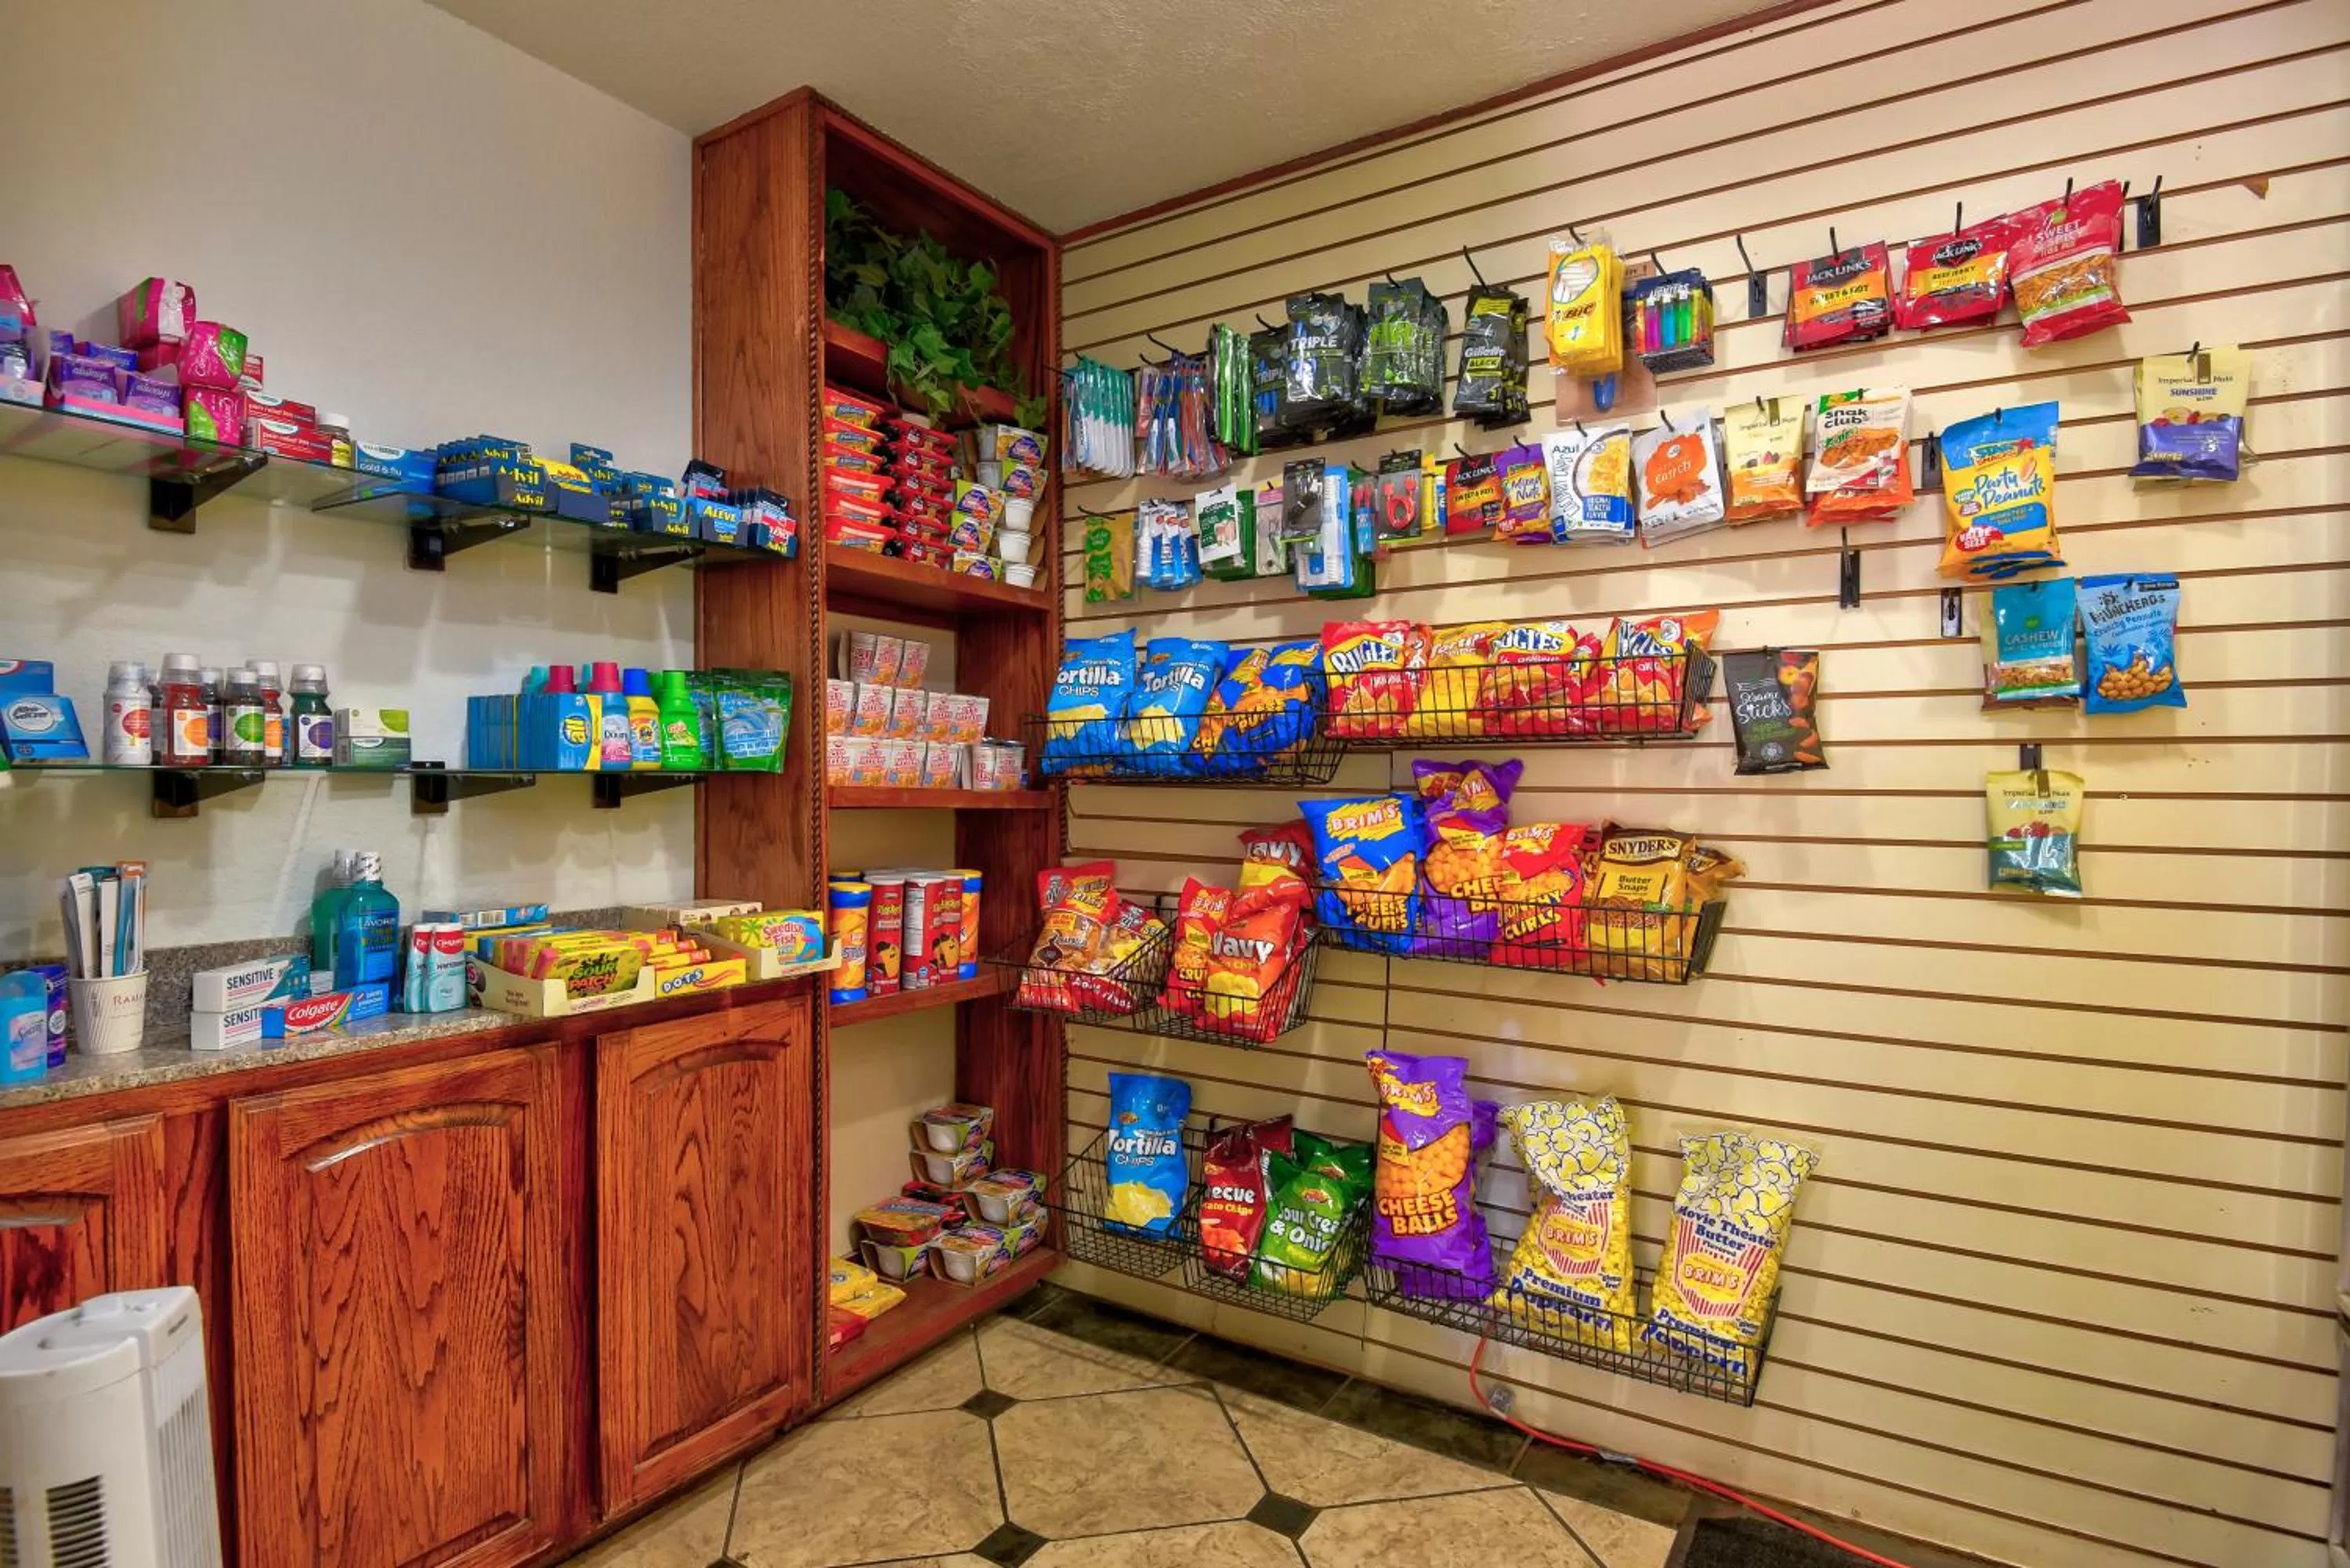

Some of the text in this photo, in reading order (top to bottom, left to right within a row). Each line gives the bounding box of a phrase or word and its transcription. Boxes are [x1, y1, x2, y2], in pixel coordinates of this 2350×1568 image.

[1806, 269, 1834, 284] JACK
[1291, 334, 1338, 350] TRIPLE
[1464, 345, 1506, 358] Gillette
[1824, 417, 1862, 428] club
[1825, 408, 1868, 419] snak
[483, 447, 509, 461] Advil
[1553, 443, 1580, 453] Azul
[360, 462, 379, 475] cold
[1974, 467, 2019, 497] Party
[1982, 474, 2046, 509] Peanuts
[513, 493, 544, 508] Advil
[2005, 630, 2059, 645] CASHEW
[1057, 666, 1123, 685] ortilla
[1142, 667, 1206, 694] Tortilla
[1736, 700, 1792, 725] Sticks
[1332, 801, 1400, 830] BRIM'S
[1608, 838, 1678, 855] SNYDER'S
[1451, 876, 1502, 898] CHEE
[1617, 883, 1649, 892] Snaps
[1618, 874, 1653, 884] Butter
[762, 920, 805, 941] Swedish
[773, 934, 797, 947] Fish
[226, 967, 274, 990] SENSITIVE
[573, 963, 617, 979] SOUR
[662, 967, 703, 994] DOTS
[569, 974, 617, 991] PATCH
[287, 999, 339, 1022] Colgate
[1107, 1128, 1177, 1156] Tortilla
[1206, 1185, 1256, 1205] ecue
[1378, 1188, 1456, 1217] CHEESE
[1224, 1201, 1254, 1216] Chips
[1269, 1219, 1285, 1237] &
[1307, 1209, 1340, 1235] Crea
[1392, 1206, 1459, 1237] BALLS
[1678, 1205, 1777, 1250] Movie Theater
[1546, 1226, 1599, 1247] BRIM'S
[1694, 1223, 1747, 1253] Butter
[1683, 1263, 1740, 1290] BRIM'S
[1522, 1266, 1604, 1308] Premium
[1656, 1307, 1738, 1350] Premium
